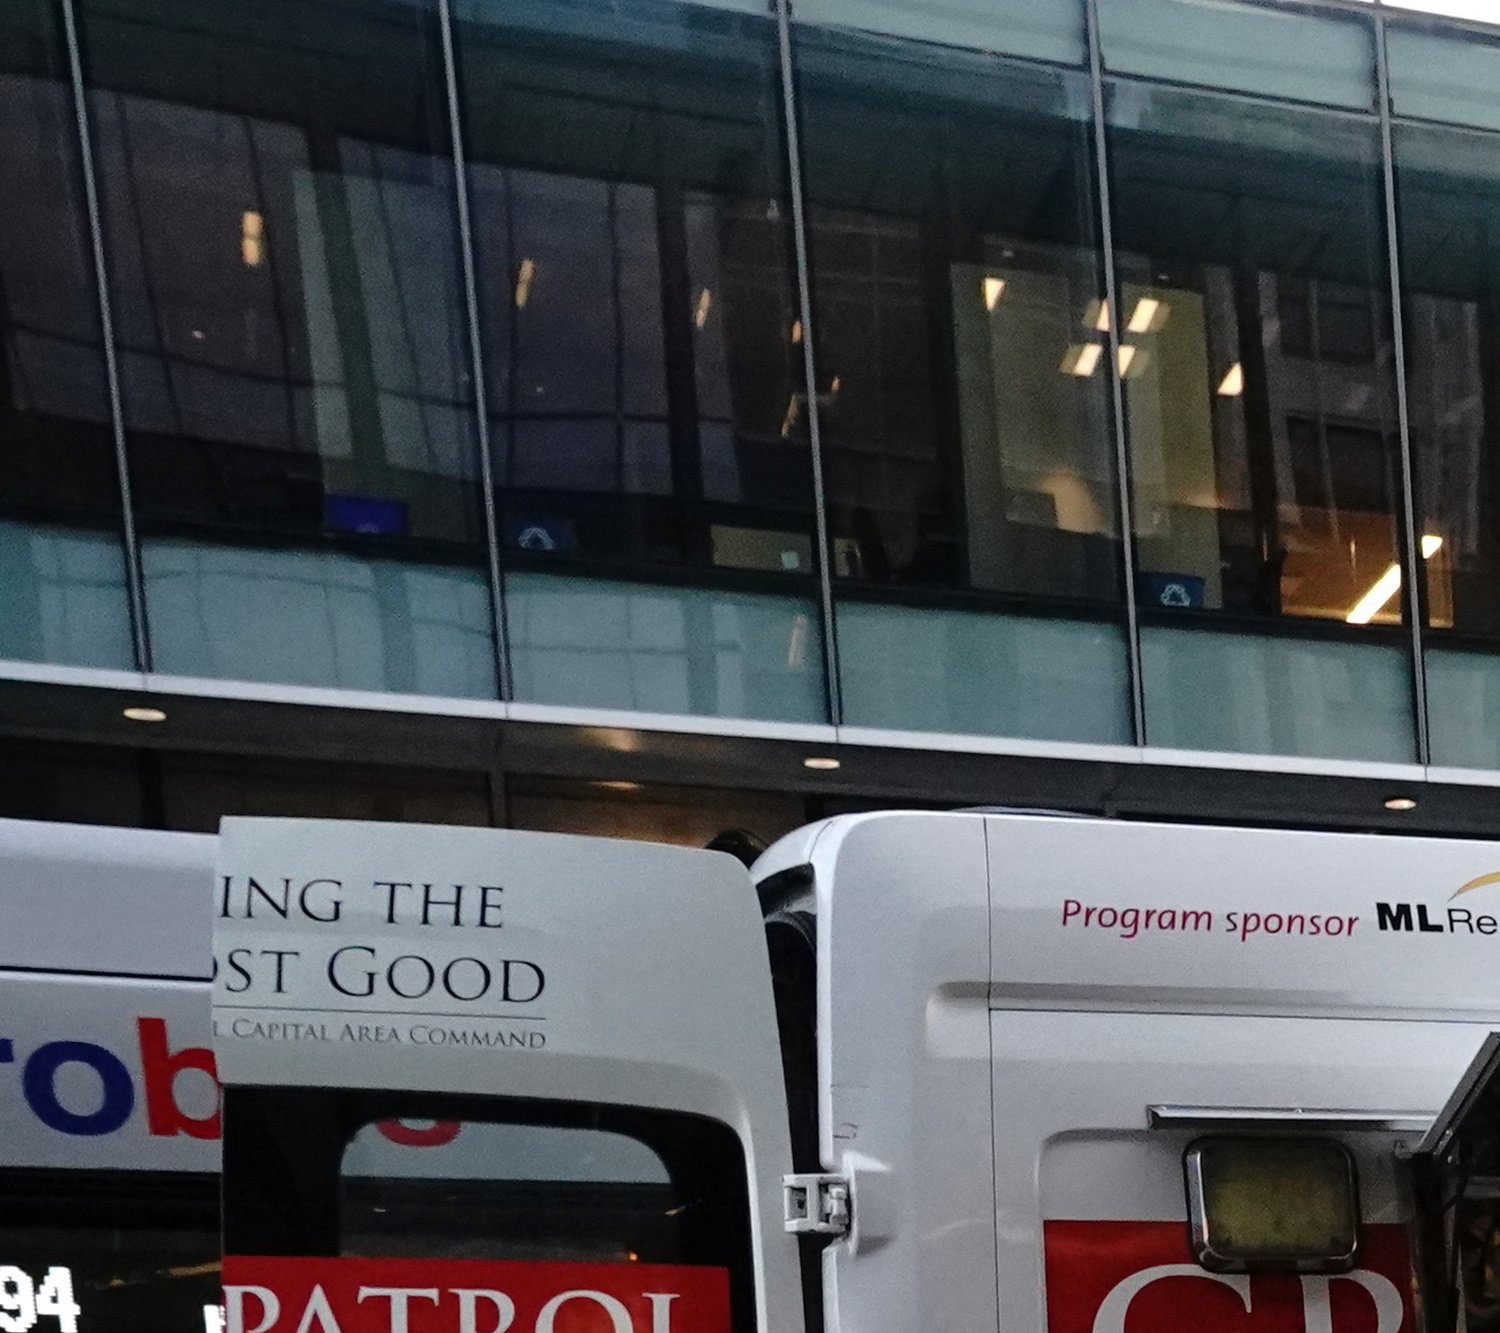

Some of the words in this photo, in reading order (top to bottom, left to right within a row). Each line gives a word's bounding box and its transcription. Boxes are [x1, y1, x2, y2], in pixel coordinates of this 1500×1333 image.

[219, 875, 343, 923] ING
[373, 880, 504, 929] THE
[1062, 899, 1212, 939] Program
[1225, 911, 1360, 942] sponsor
[212, 947, 300, 994] ST
[340, 1023, 401, 1044] AREA
[409, 1024, 547, 1050] COMMAND
